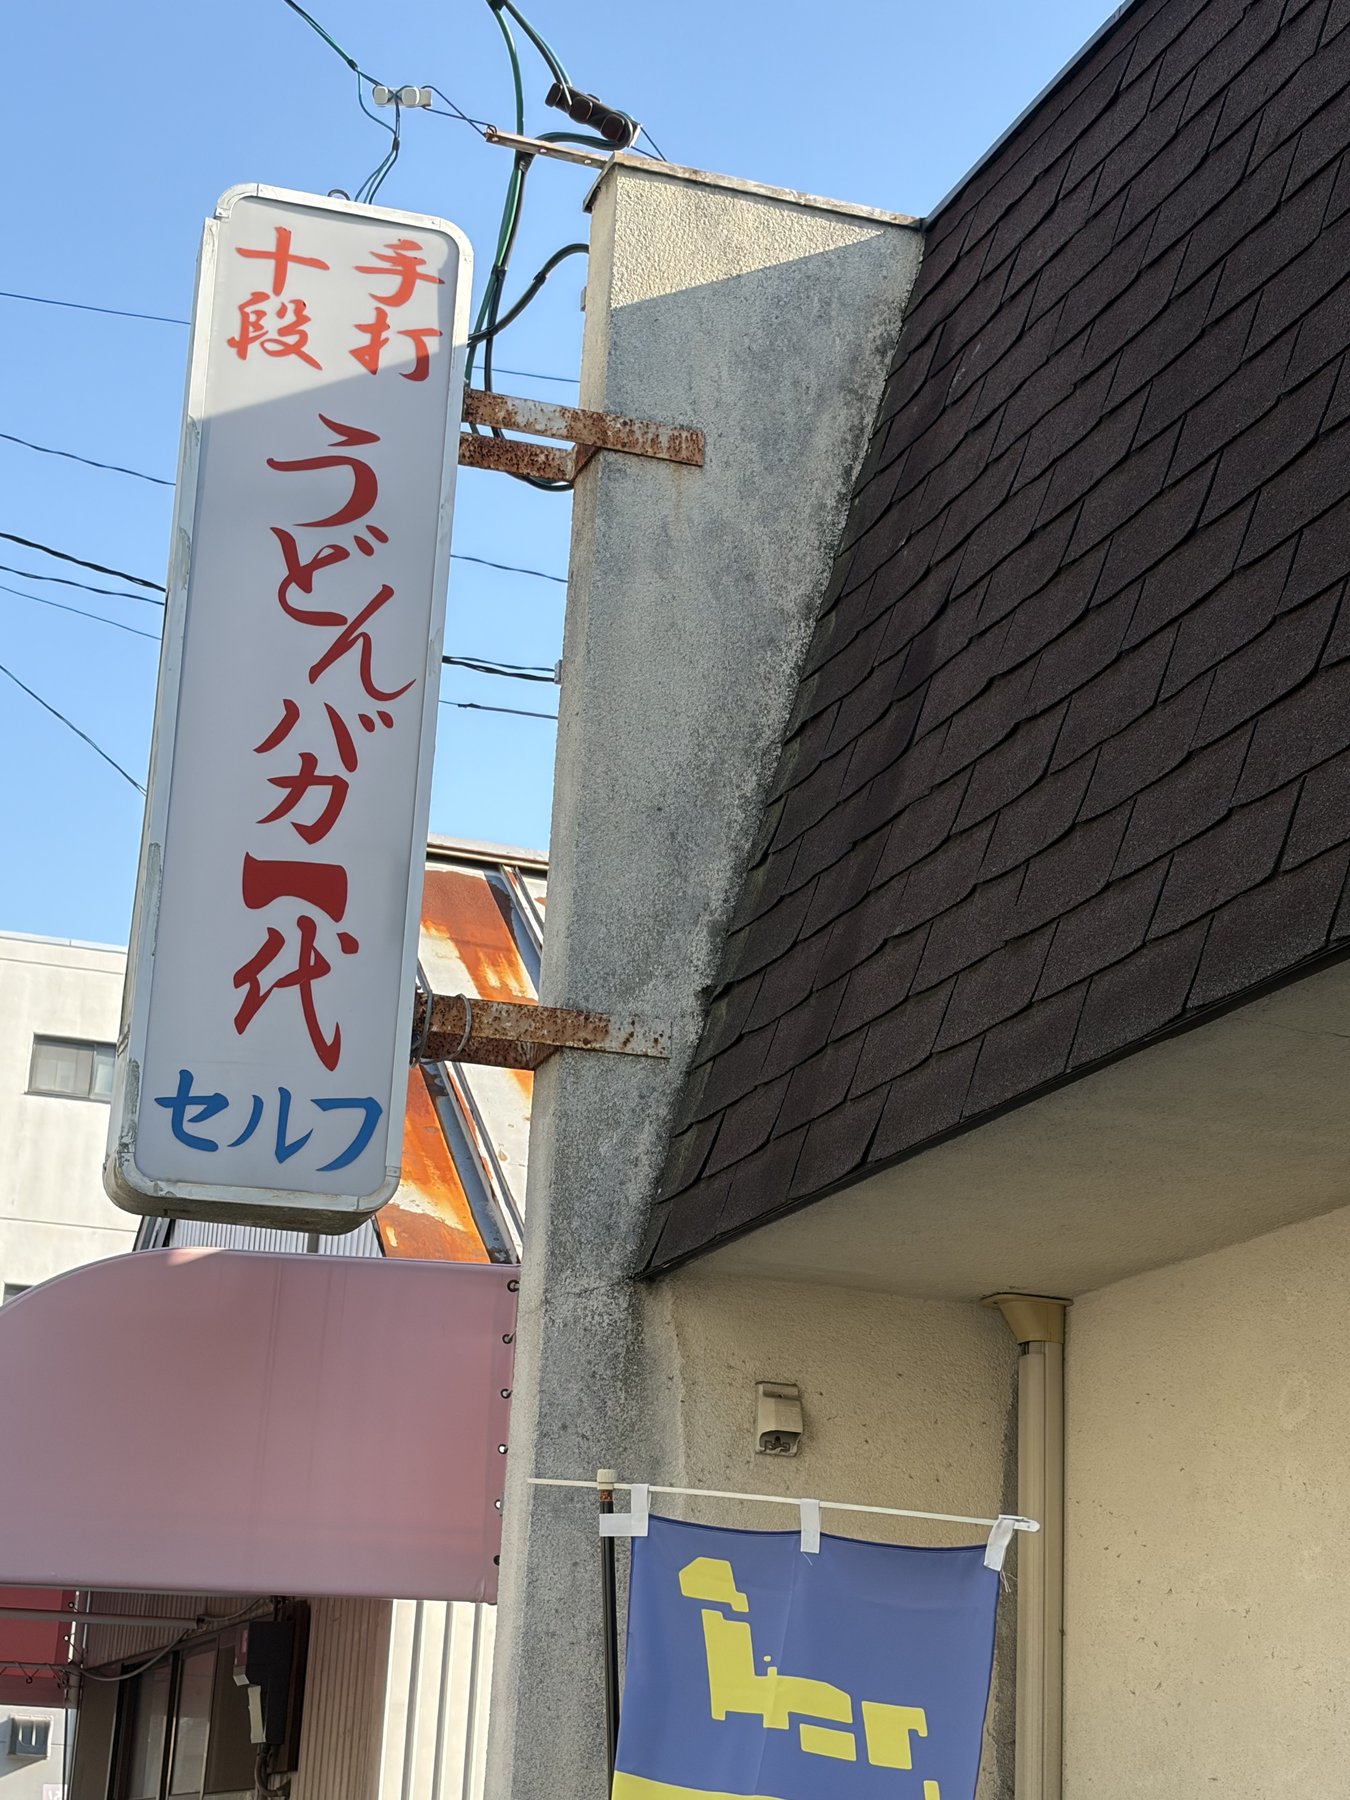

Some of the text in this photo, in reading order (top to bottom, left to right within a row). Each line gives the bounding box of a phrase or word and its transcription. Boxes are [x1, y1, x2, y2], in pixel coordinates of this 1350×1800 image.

[227, 226, 329, 370] 十段
[349, 239, 445, 382] 手打
[233, 413, 416, 1072] うどんバカ一代
[154, 1069, 383, 1172] セルフ
